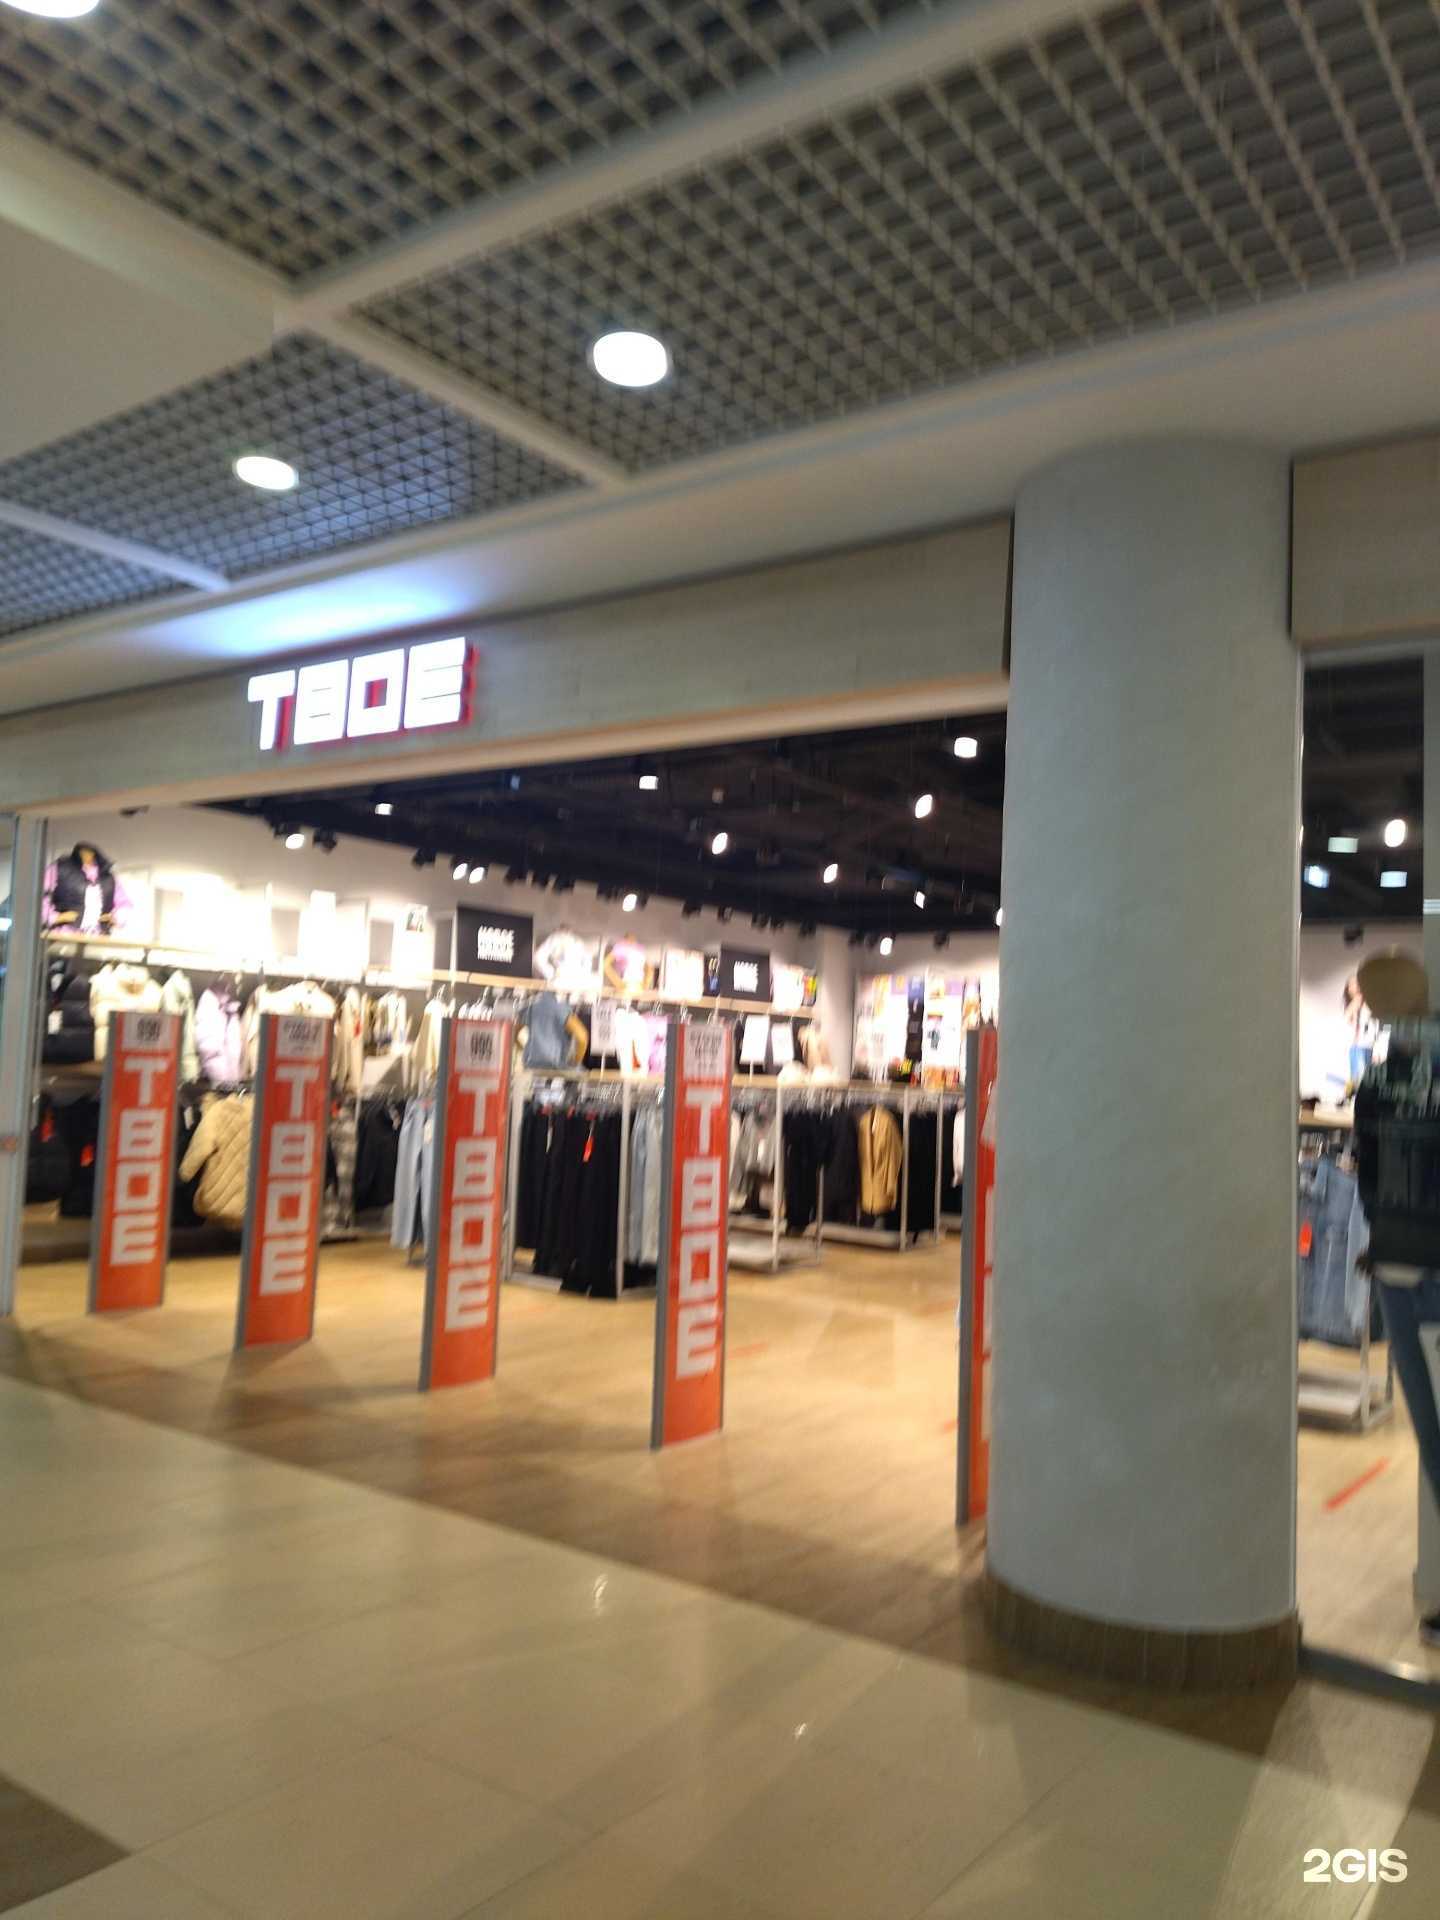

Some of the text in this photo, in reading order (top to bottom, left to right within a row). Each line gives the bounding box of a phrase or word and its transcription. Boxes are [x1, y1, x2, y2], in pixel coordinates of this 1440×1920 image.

[248, 637, 466, 750] ТВОЕ
[110, 1056, 168, 1266] ТВОЕ
[259, 1064, 319, 1296] ТВОЕ
[445, 1075, 500, 1332] ТВОЕ
[675, 1086, 723, 1379] ТВОЕ
